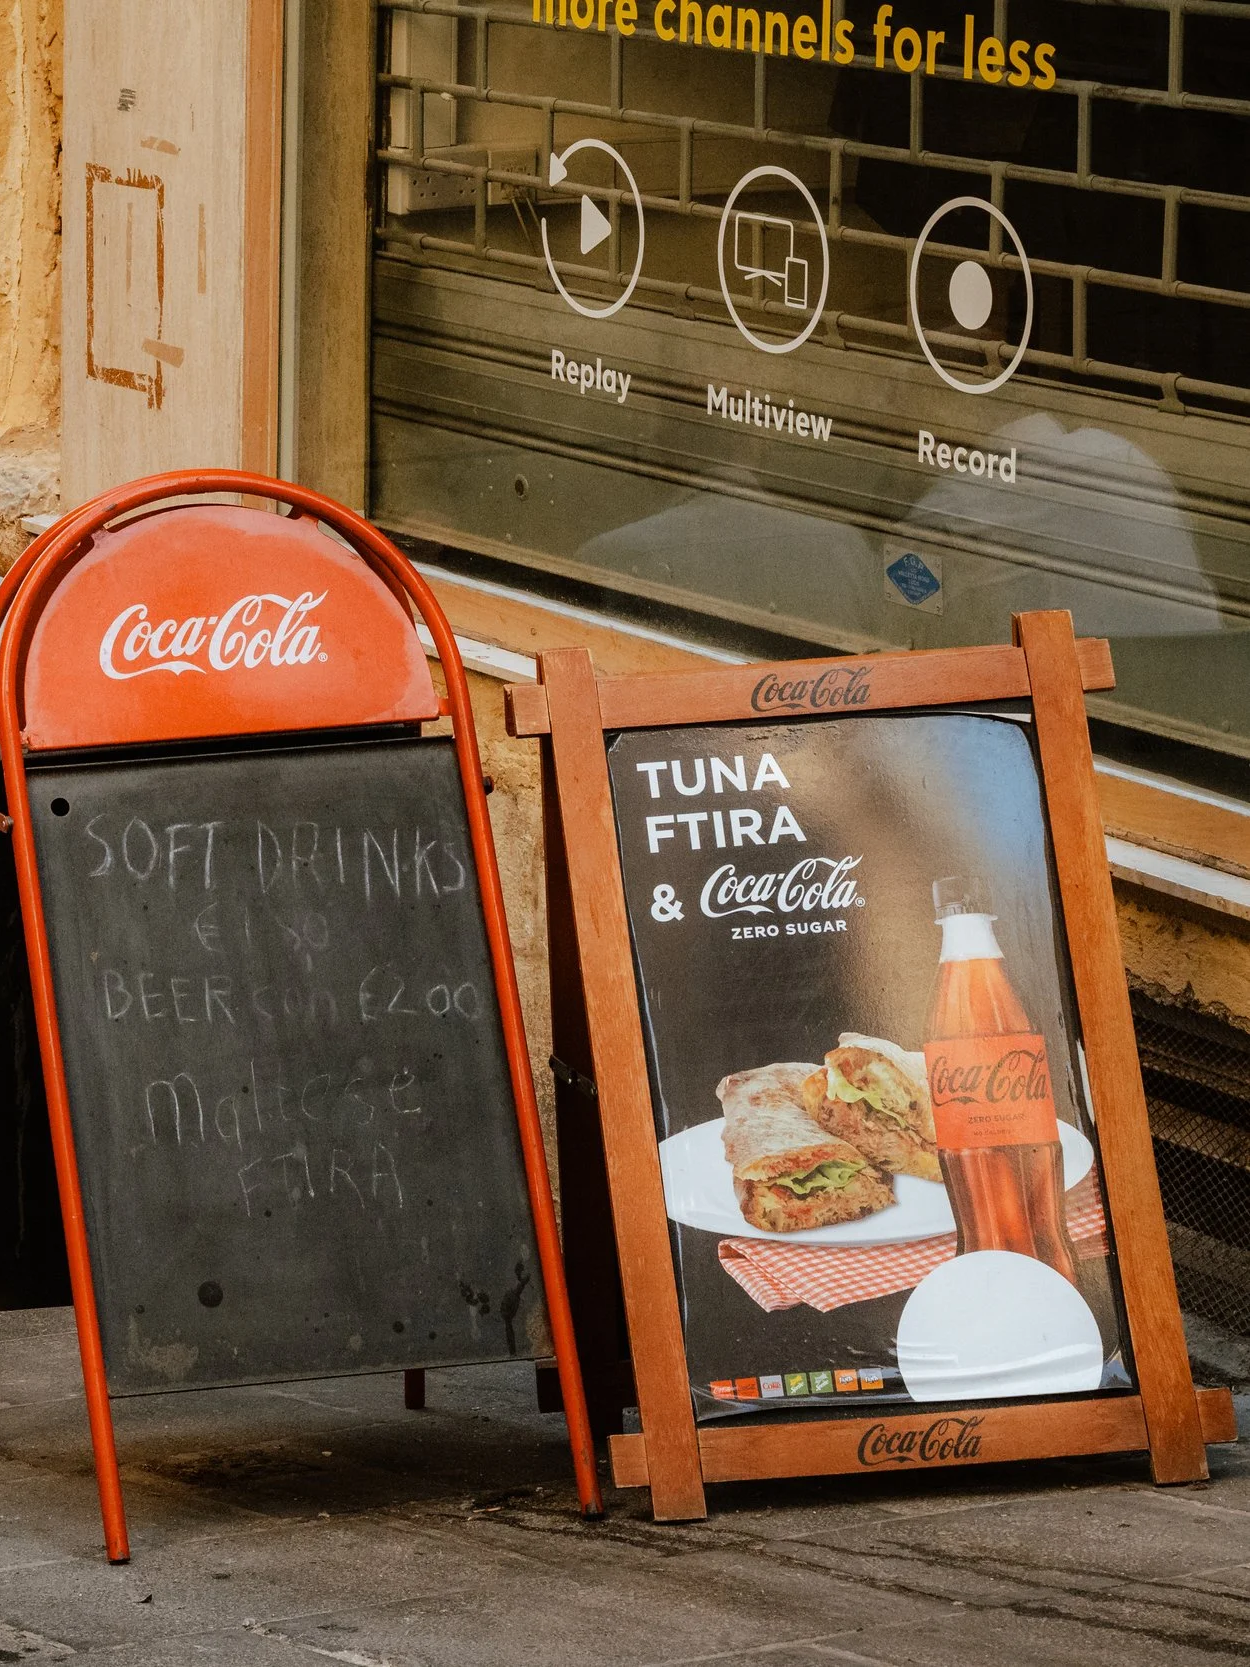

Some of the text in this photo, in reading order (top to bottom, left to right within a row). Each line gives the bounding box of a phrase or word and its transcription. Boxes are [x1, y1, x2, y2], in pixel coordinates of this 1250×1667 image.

[533, 0, 1056, 90] more channels for less
[550, 349, 632, 404] Replay
[706, 384, 833, 442] Multiview
[917, 430, 1017, 484] Record
[99, 590, 329, 680] Coca-Cola
[750, 666, 874, 713] Coca-Cola
[636, 753, 791, 799] TUNA
[85, 813, 467, 900] SOFT DRINKS
[645, 805, 808, 854] FTIRA
[651, 883, 685, 923] &
[731, 918, 848, 940] ZERO SUGAR
[103, 968, 237, 1027] BEER
[930, 1049, 1049, 1107] Coca-Cola
[968, 1116, 991, 1124] ZERO
[858, 1416, 985, 1466] Coca-Cola
